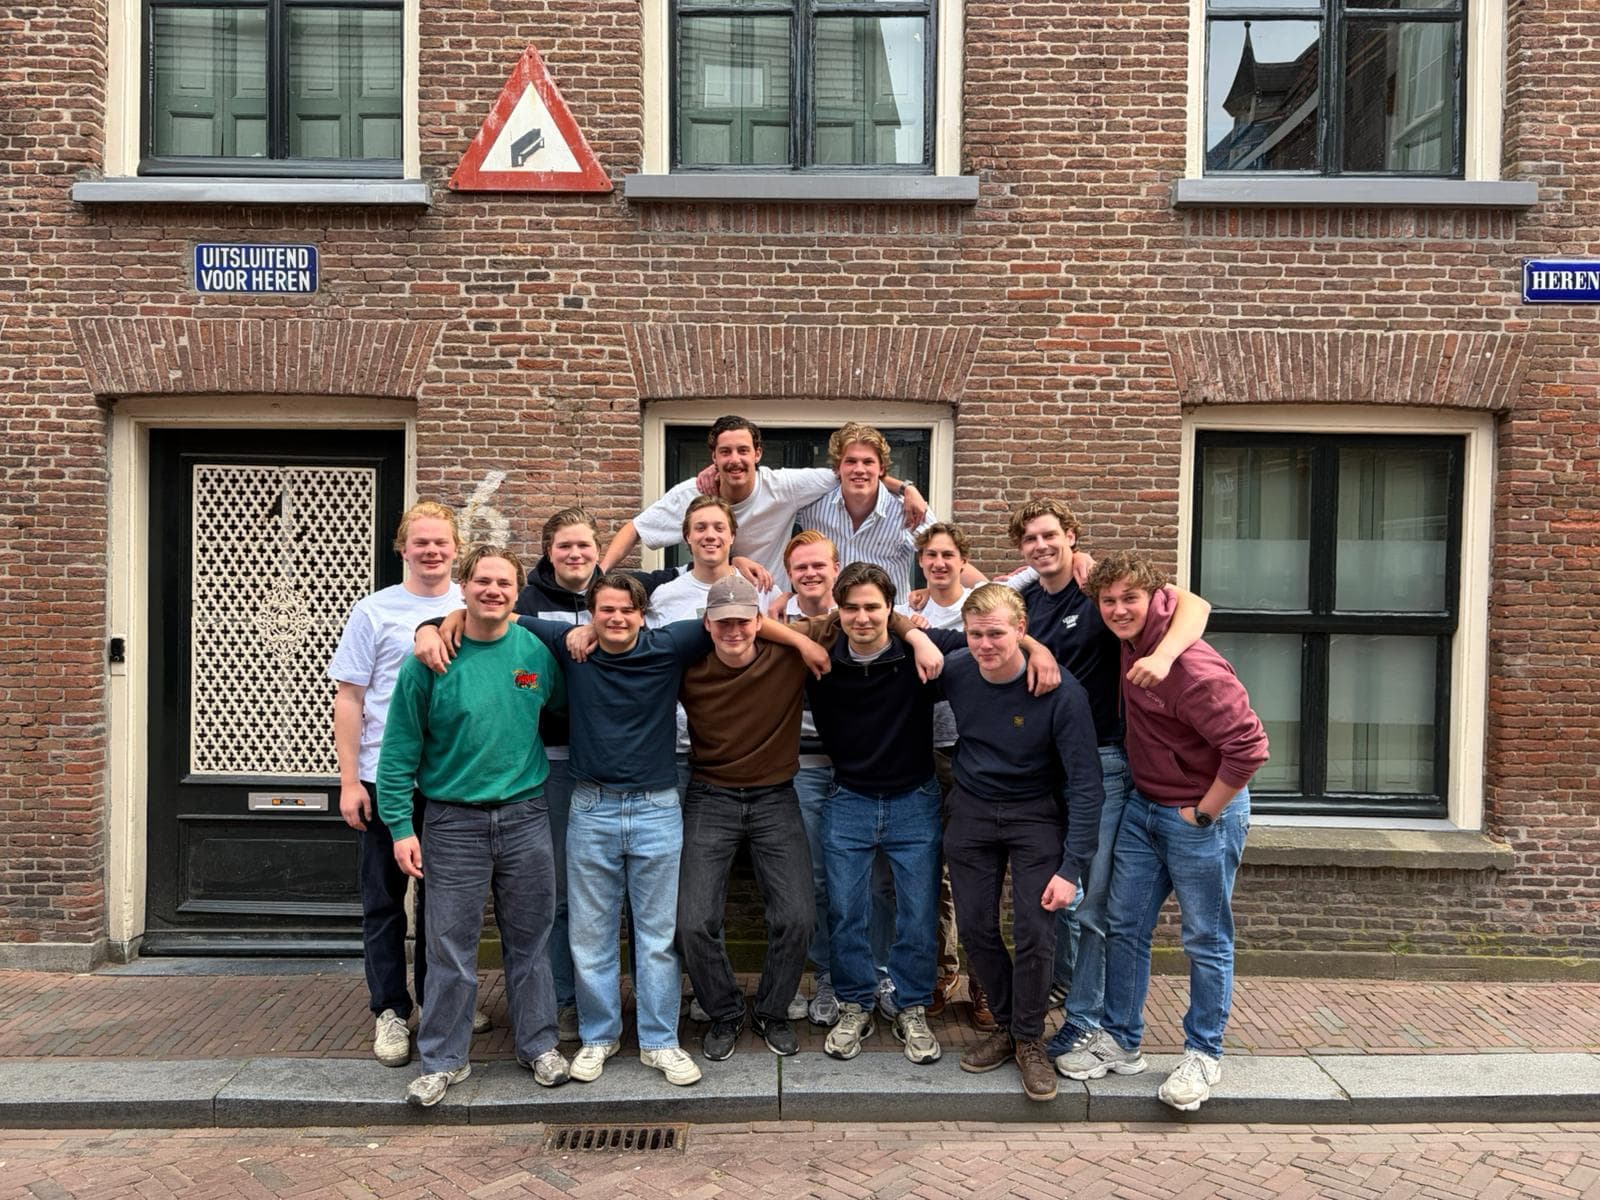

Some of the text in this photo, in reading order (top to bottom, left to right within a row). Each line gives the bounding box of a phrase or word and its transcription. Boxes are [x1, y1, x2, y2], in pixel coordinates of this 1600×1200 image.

[202, 247, 309, 269] UITSLUITEND
[201, 269, 311, 292] VOOR HEREN
[1532, 270, 1600, 290] HEREN
